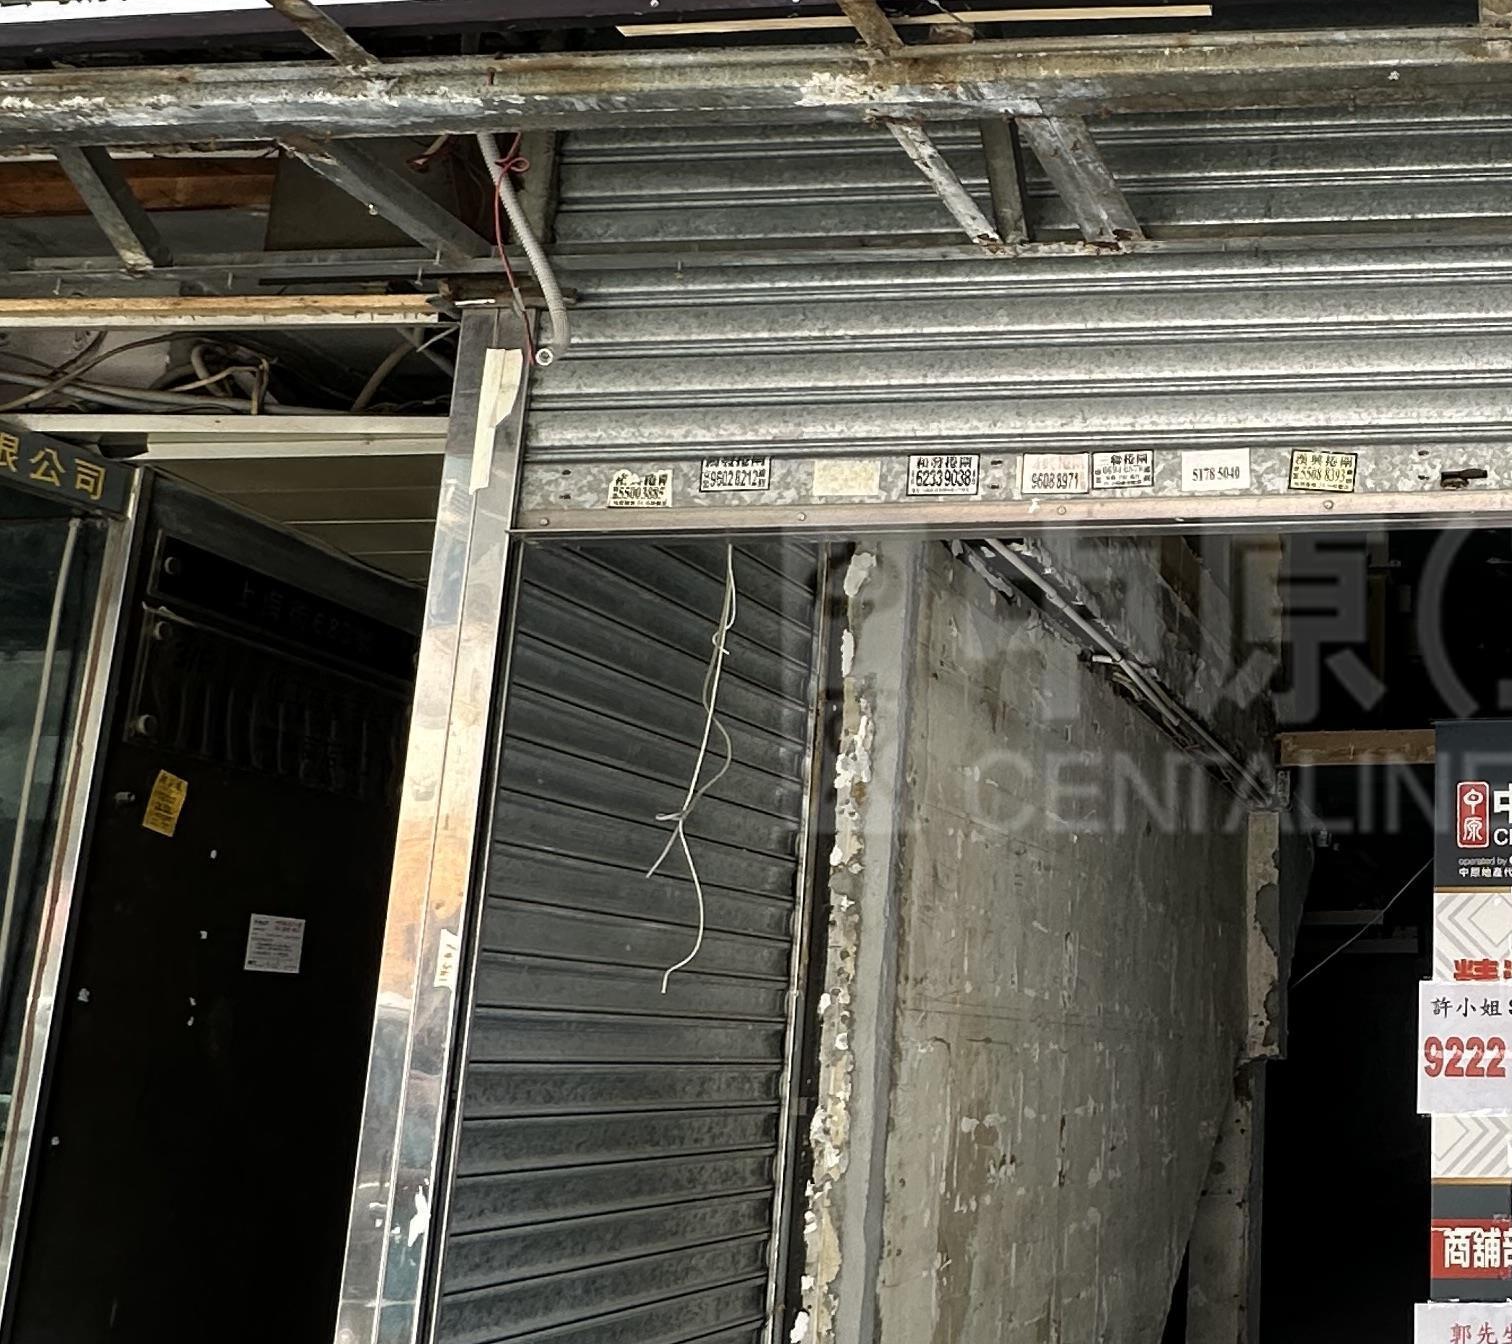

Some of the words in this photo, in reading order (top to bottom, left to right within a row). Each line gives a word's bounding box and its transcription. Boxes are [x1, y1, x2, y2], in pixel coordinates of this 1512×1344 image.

[1431, 996, 1502, 1018] 許小姐
[1424, 1036, 1506, 1078] 9222
